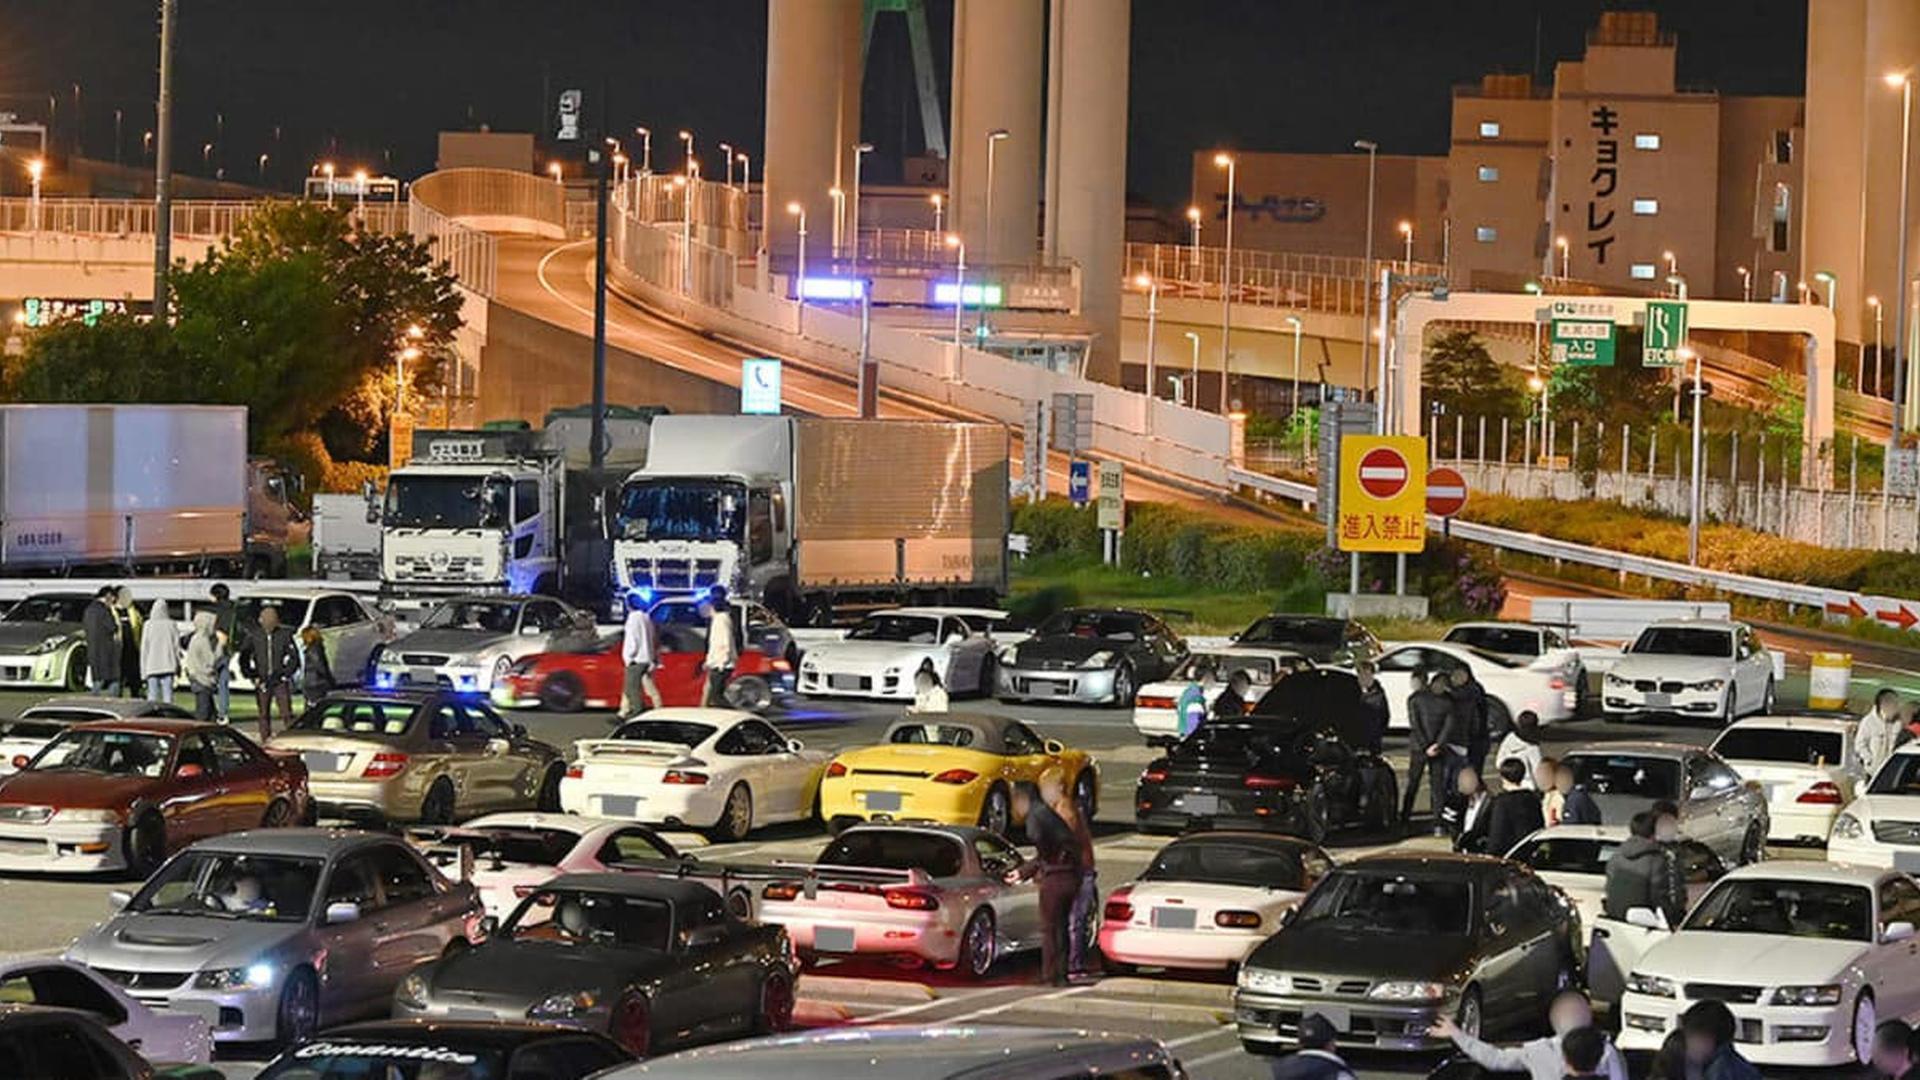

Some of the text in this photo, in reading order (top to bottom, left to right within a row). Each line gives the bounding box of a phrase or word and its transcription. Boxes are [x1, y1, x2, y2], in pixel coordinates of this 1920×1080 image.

[1588, 106, 1618, 264] キョクレイ
[1570, 340, 1596, 352] 入口
[1343, 512, 1421, 540] 進入禁止
